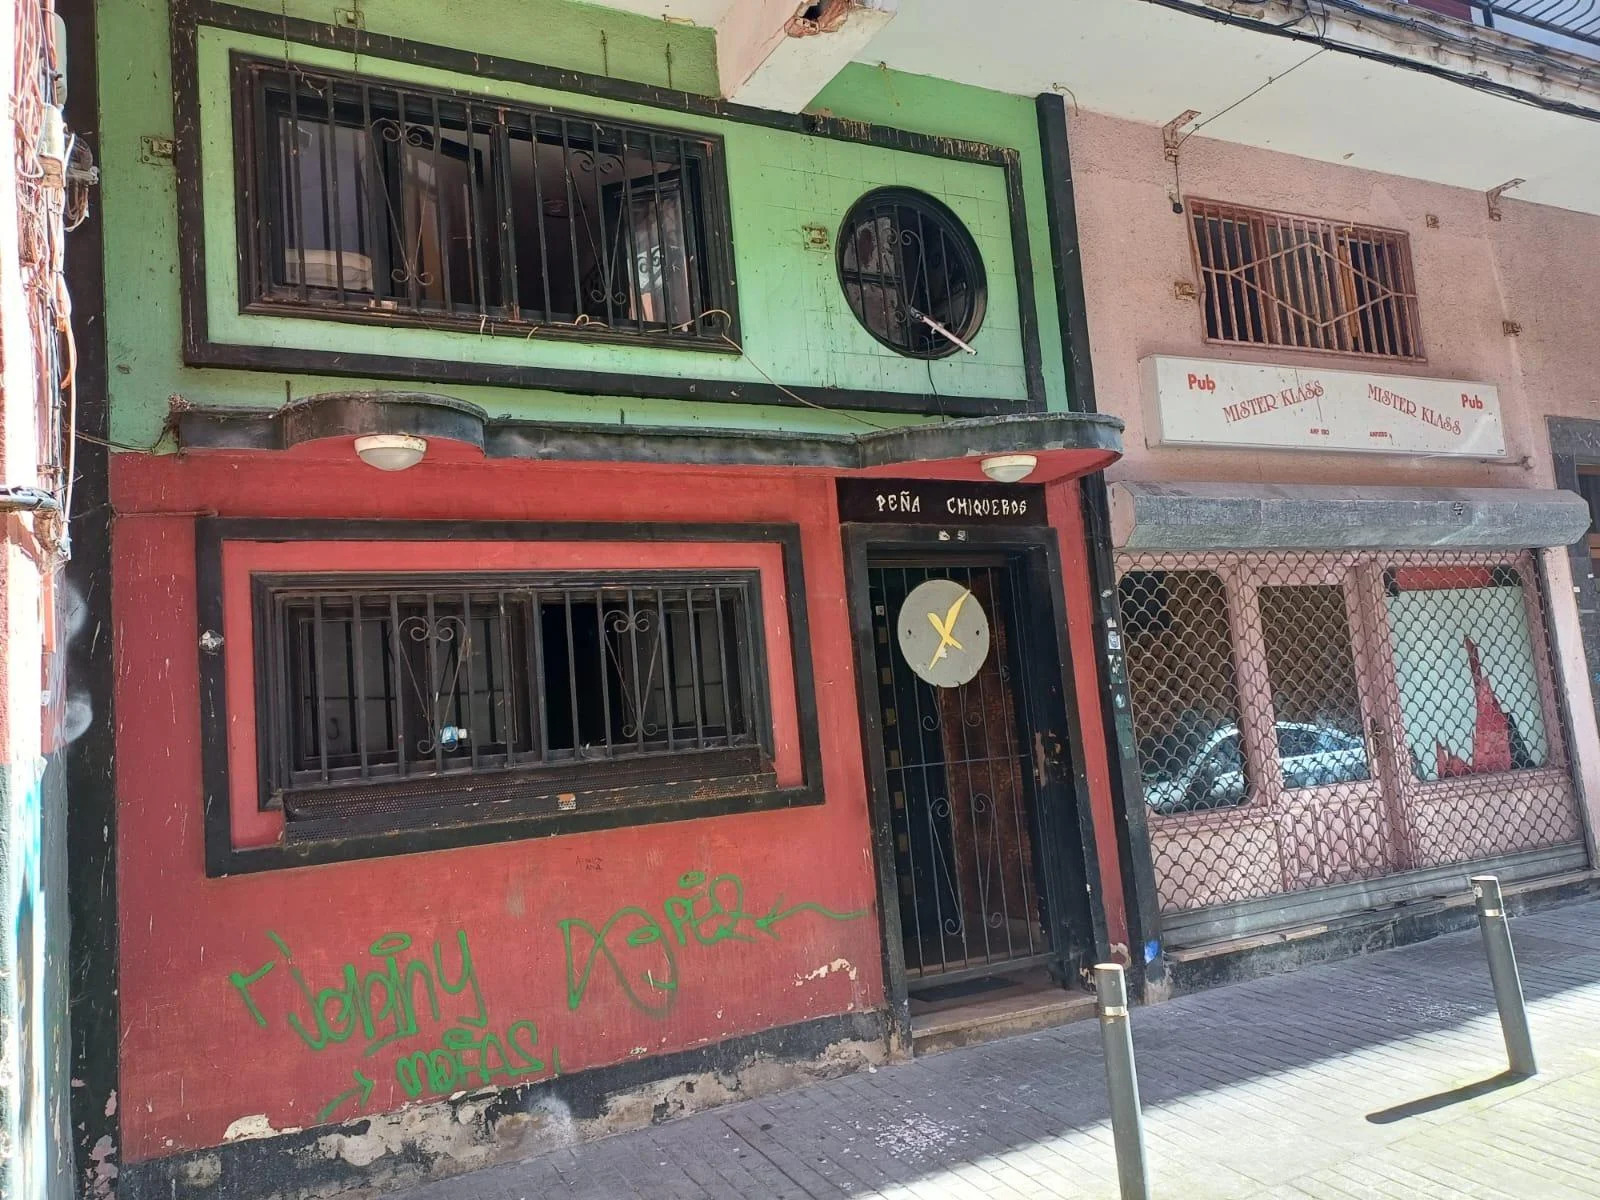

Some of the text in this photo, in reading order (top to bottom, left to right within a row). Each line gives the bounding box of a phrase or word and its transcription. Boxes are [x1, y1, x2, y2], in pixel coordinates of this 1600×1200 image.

[1187, 373, 1216, 391] Pub
[1222, 380, 1325, 424] MISTER KLASS
[1367, 383, 1462, 436] MISTER KLASS
[1460, 393, 1484, 410] Pub
[875, 490, 1027, 517] PEÑA CHIQUEROS
